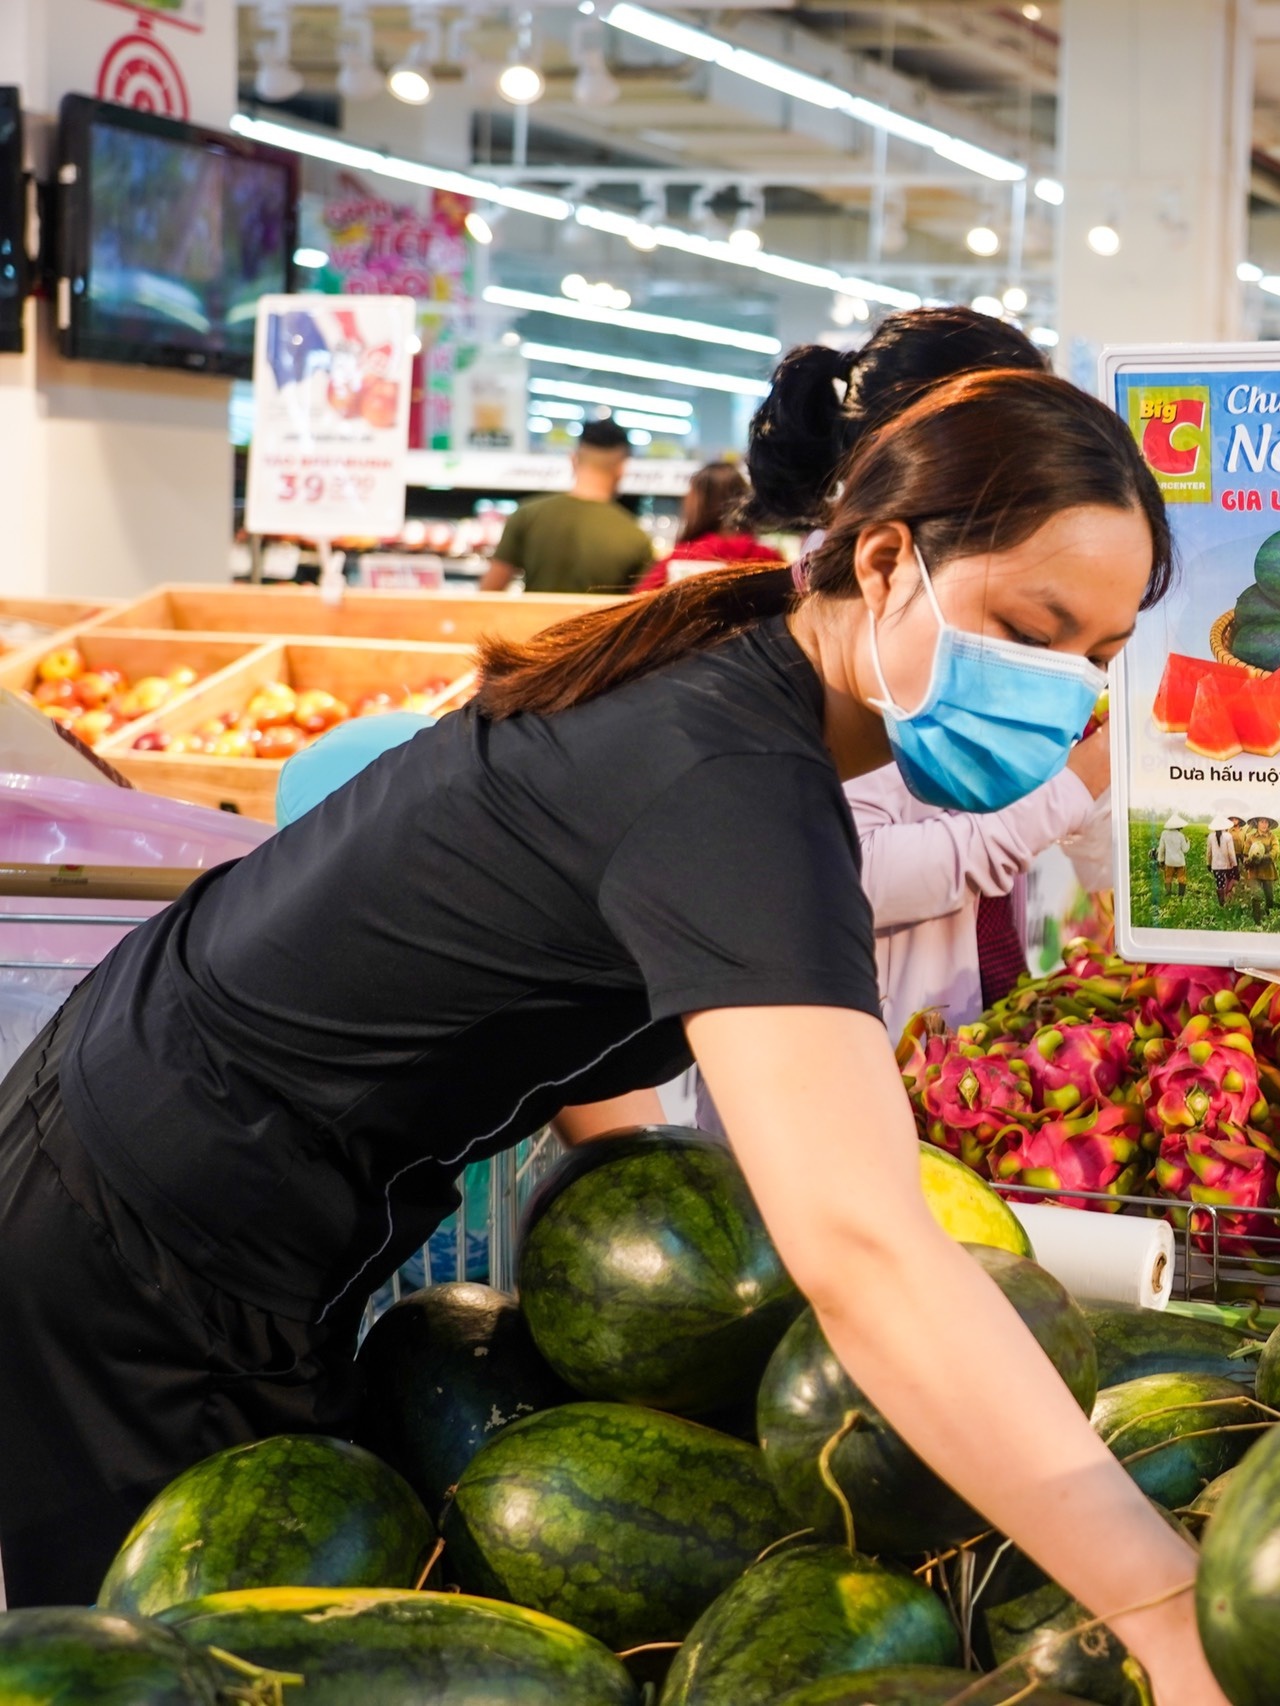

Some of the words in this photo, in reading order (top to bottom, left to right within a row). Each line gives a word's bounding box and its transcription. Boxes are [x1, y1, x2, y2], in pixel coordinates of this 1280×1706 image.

[1140, 399, 1177, 424] Big
[1142, 399, 1206, 477] C
[278, 473, 325, 503] 39
[1221, 488, 1263, 511] GIA
[1169, 765, 1205, 782] Dưa
[1209, 764, 1243, 782] hấu
